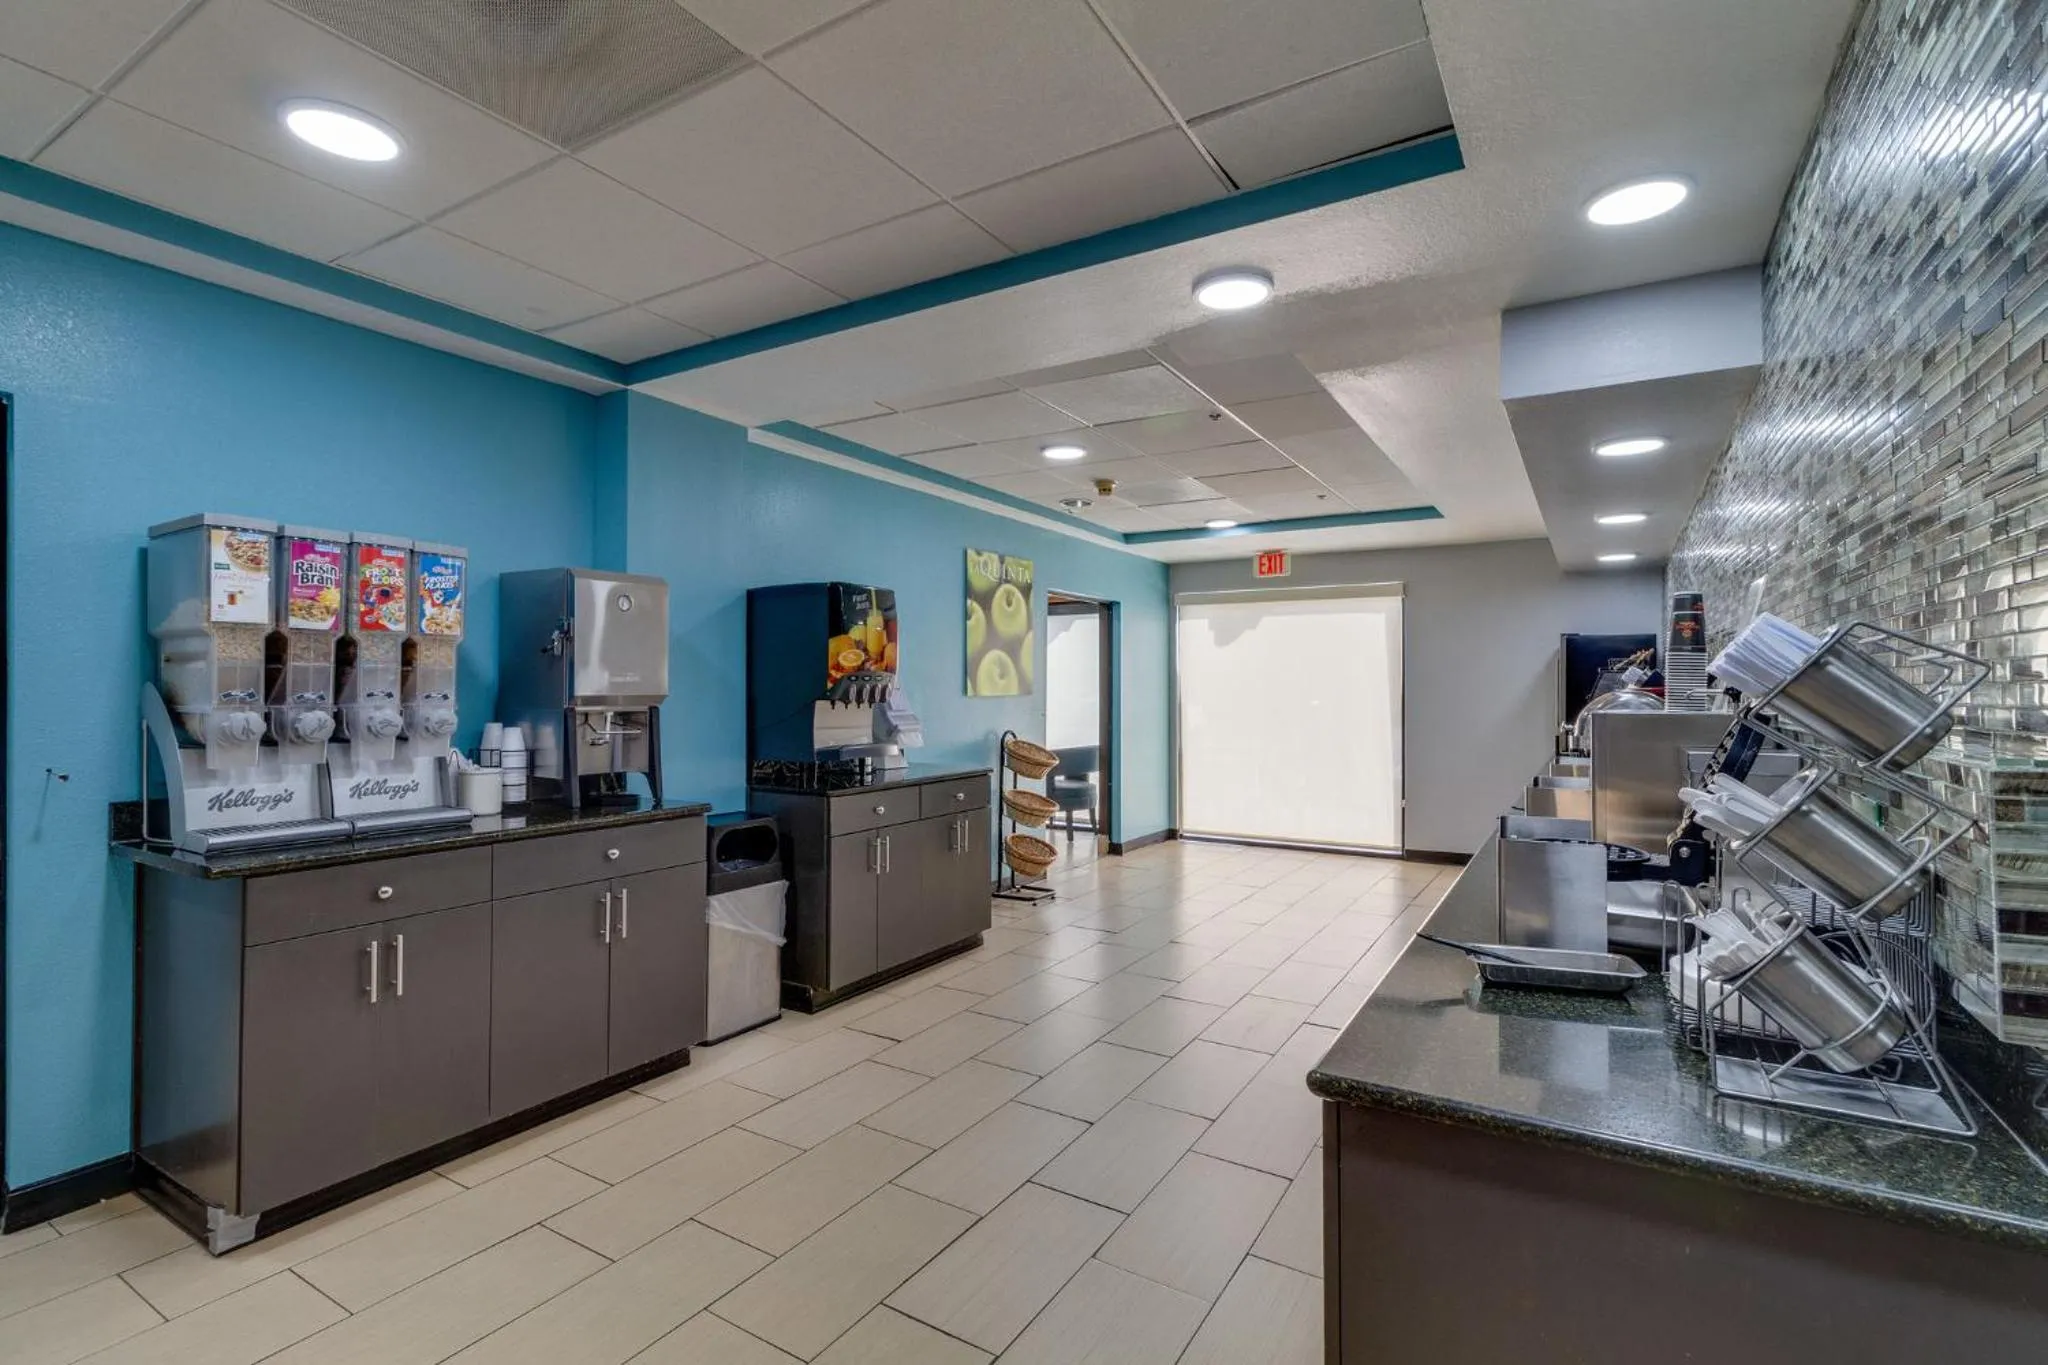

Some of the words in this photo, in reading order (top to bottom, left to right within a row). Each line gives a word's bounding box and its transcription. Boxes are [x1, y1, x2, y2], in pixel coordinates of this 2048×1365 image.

[295, 561, 338, 578] Raisin
[980, 558, 1031, 584] QUINTA
[1258, 553, 1284, 576] EXIT
[301, 573, 333, 585] Bran
[349, 778, 420, 800] Kellogg's
[207, 788, 294, 813] Kellogg's
